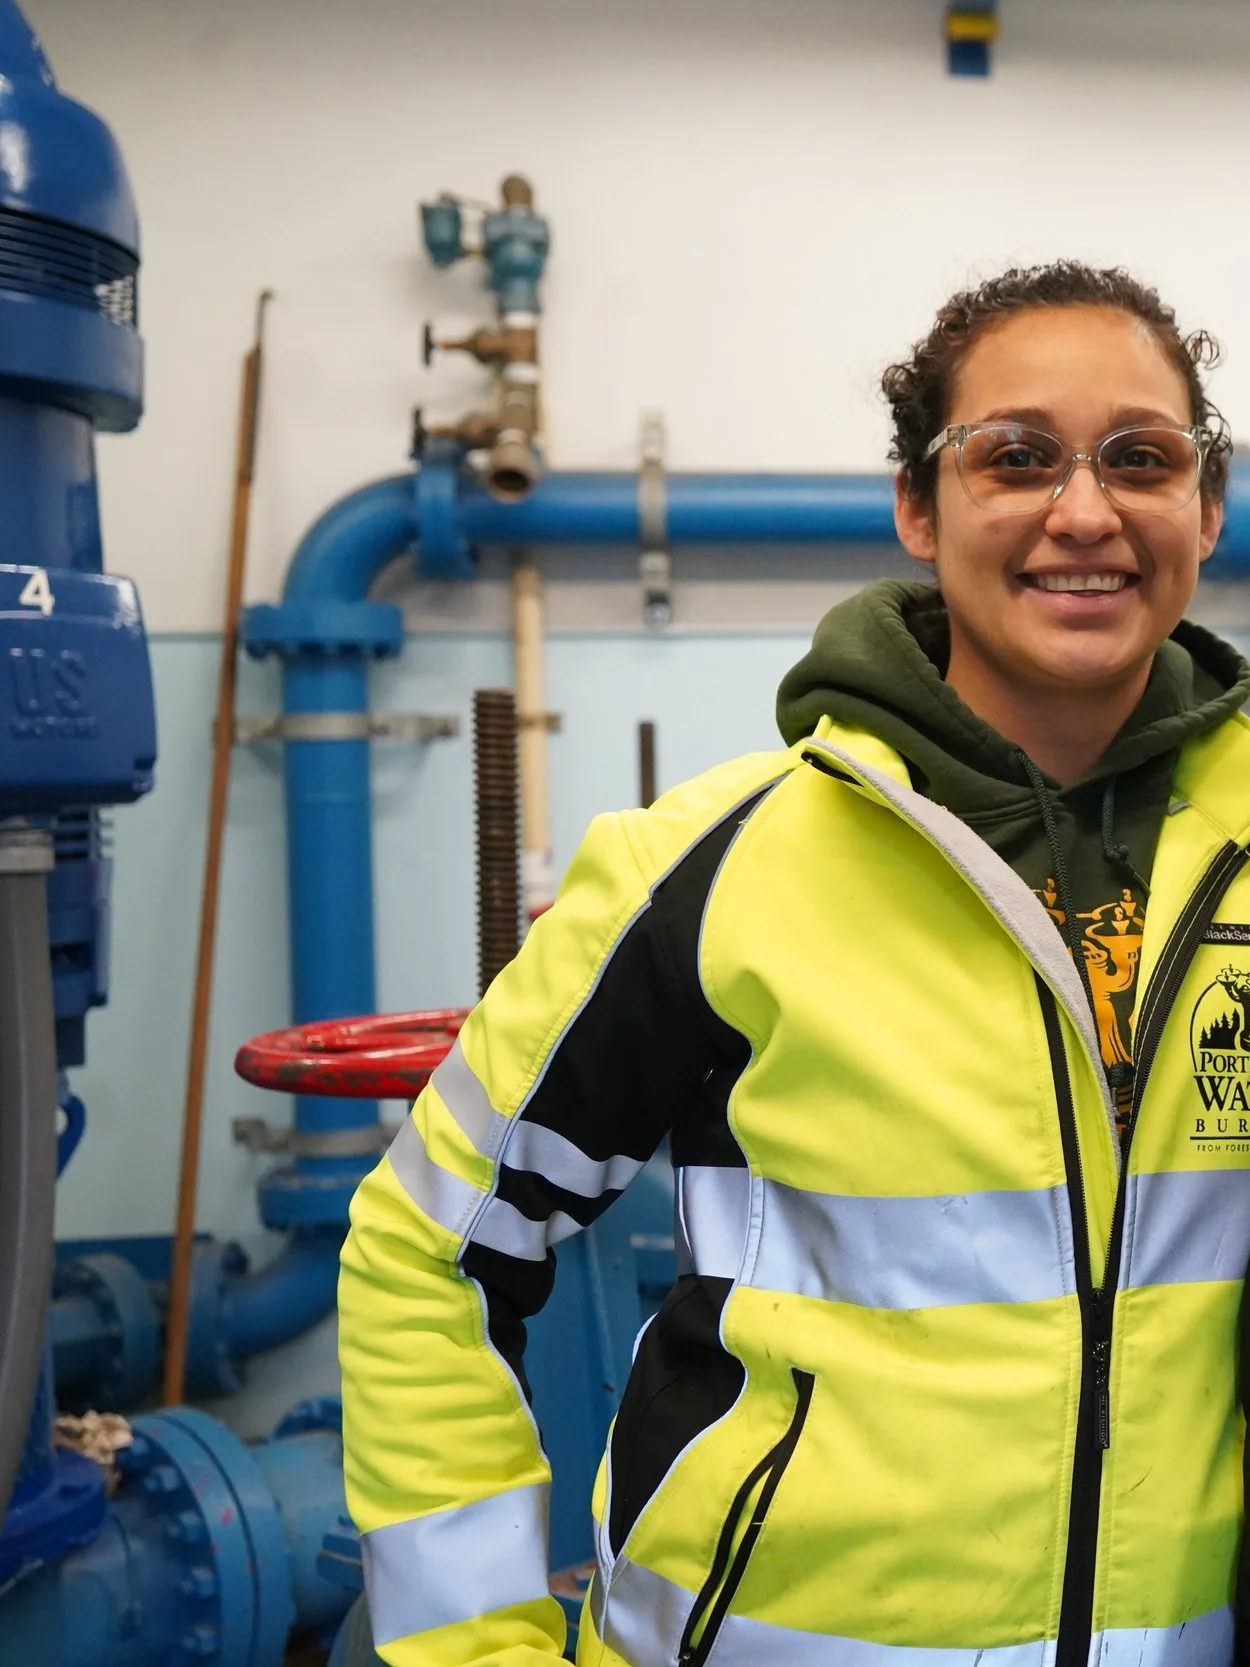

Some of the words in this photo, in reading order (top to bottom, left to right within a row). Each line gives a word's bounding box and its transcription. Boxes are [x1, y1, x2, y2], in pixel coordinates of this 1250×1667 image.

[19, 569, 55, 616] 4
[9, 647, 87, 717] US
[1197, 1144, 1221, 1152] FROM
